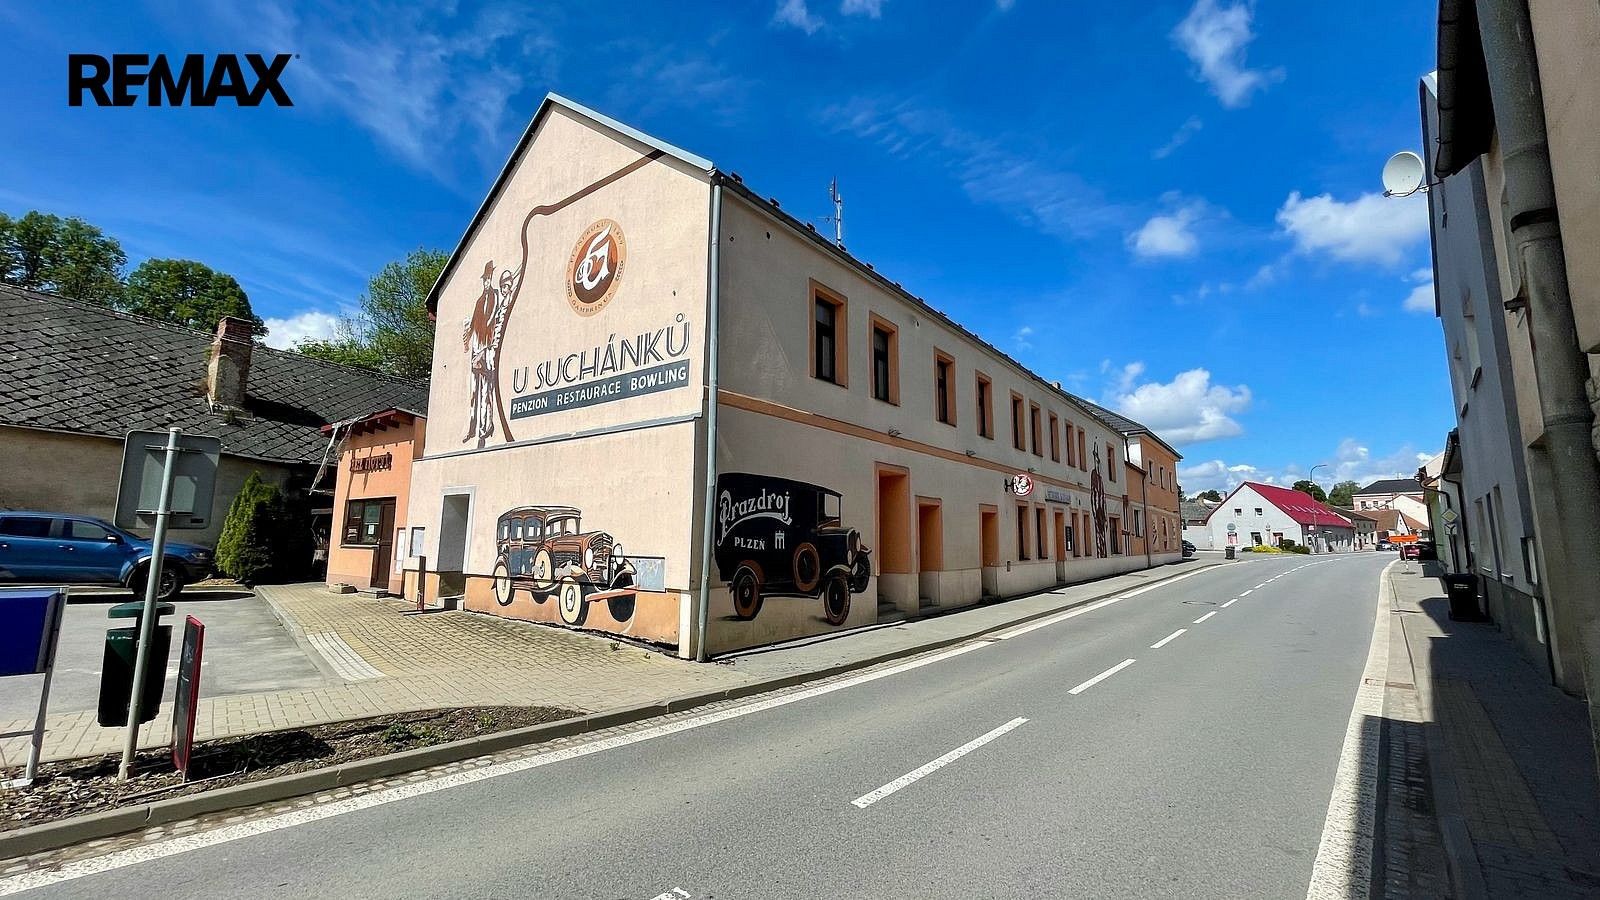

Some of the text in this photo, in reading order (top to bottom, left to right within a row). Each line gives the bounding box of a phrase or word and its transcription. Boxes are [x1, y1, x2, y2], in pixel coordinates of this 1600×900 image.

[513, 312, 690, 394] U SUCHÁNKŮ
[512, 366, 687, 414] PENZION RESTAURACE BOWLING
[717, 488, 793, 546] Prazdroj
